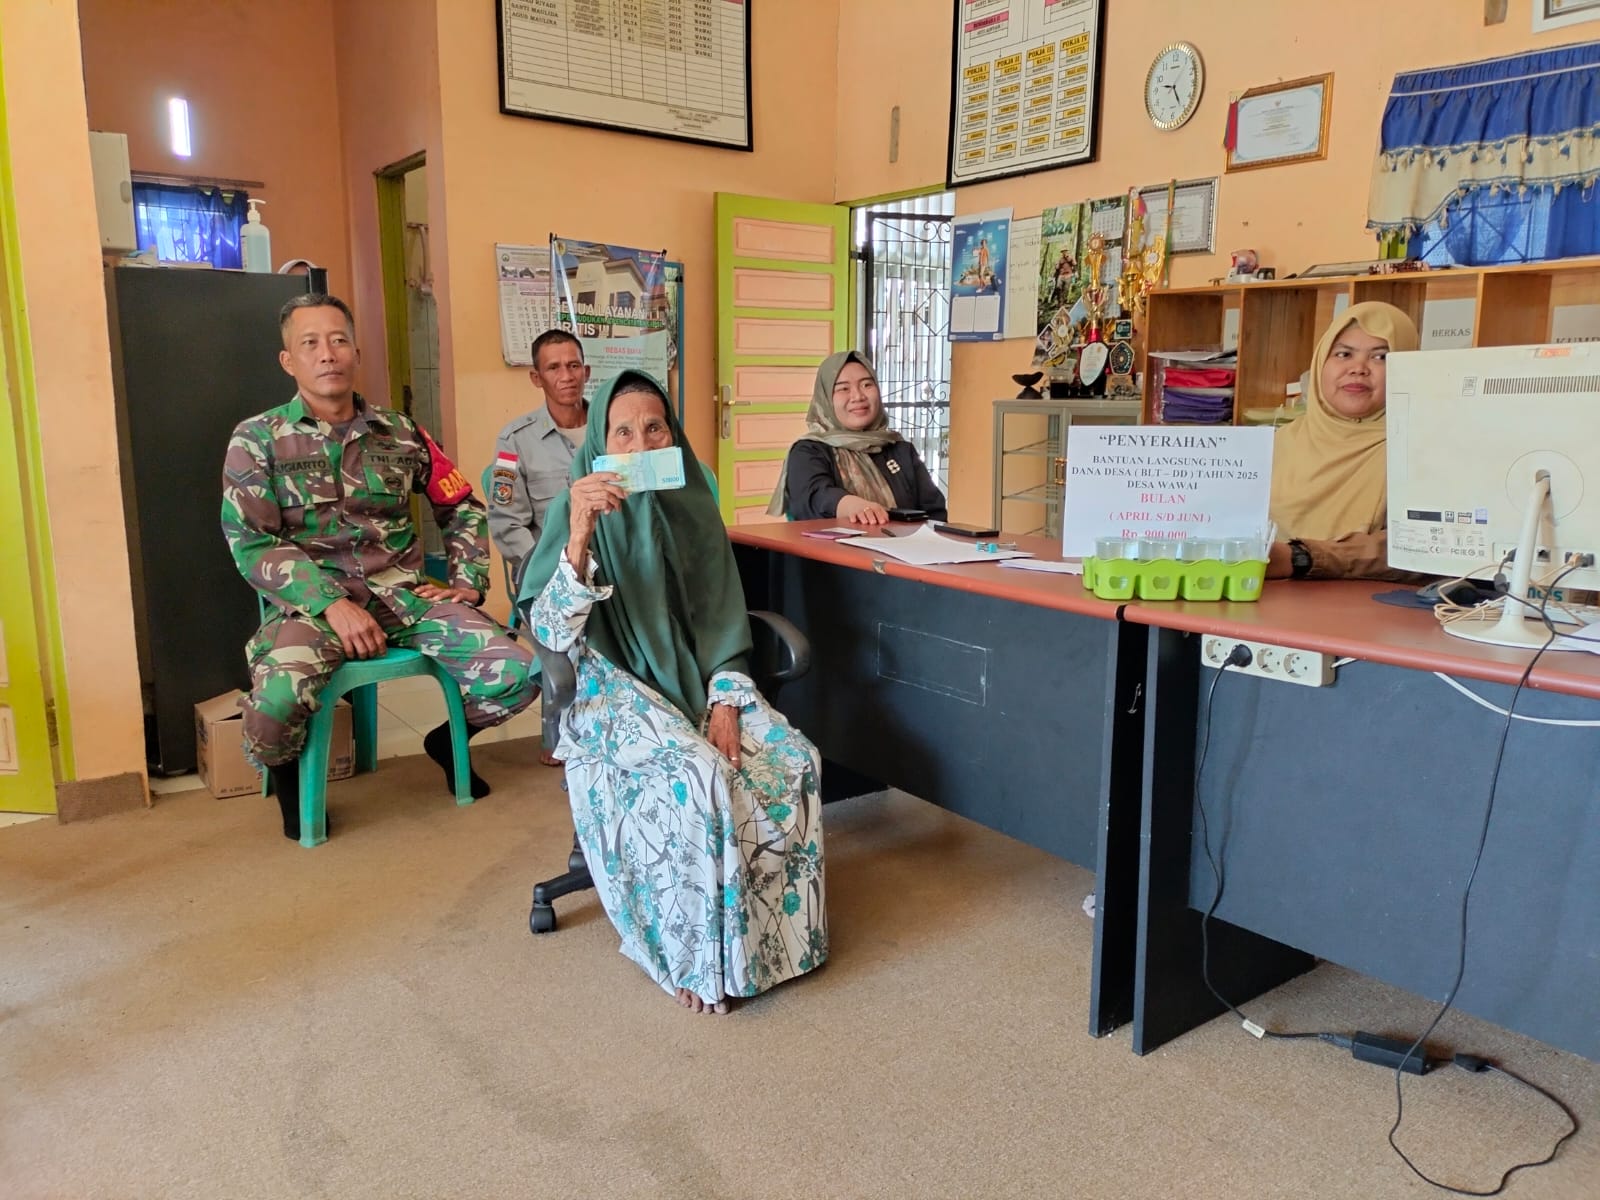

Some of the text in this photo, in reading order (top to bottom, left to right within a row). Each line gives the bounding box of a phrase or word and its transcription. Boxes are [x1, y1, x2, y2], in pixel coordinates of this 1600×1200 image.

[1062, 38, 1080, 49] POKJA
[1028, 48, 1046, 58] POKJA
[996, 57, 1014, 67] POKJA
[966, 66, 983, 76] POKJA
[598, 303, 645, 320] LAYANAN
[1431, 328, 1472, 338] BERKAS
[1099, 434, 1228, 449] “PENYERAHAN”
[369, 455, 390, 463] TNI
[1092, 455, 1244, 468] BANTUAN LANGSUNG TUNAI
[275, 460, 327, 474] UGIARTO
[1071, 467, 1101, 476] DANA
[1104, 467, 1131, 477] DESA
[1140, 468, 1161, 477] BLT
[1172, 469, 1188, 478] DD
[1196, 470, 1235, 479] TAHUN
[1236, 471, 1259, 480] 2025
[1126, 480, 1199, 490] DESA WAWAI
[1140, 493, 1187, 504] BULAN
[1116, 511, 1152, 521] APRIL
[1155, 512, 1175, 522] S/D
[1176, 512, 1205, 522] JUNI
[1144, 529, 1188, 539] 900000
